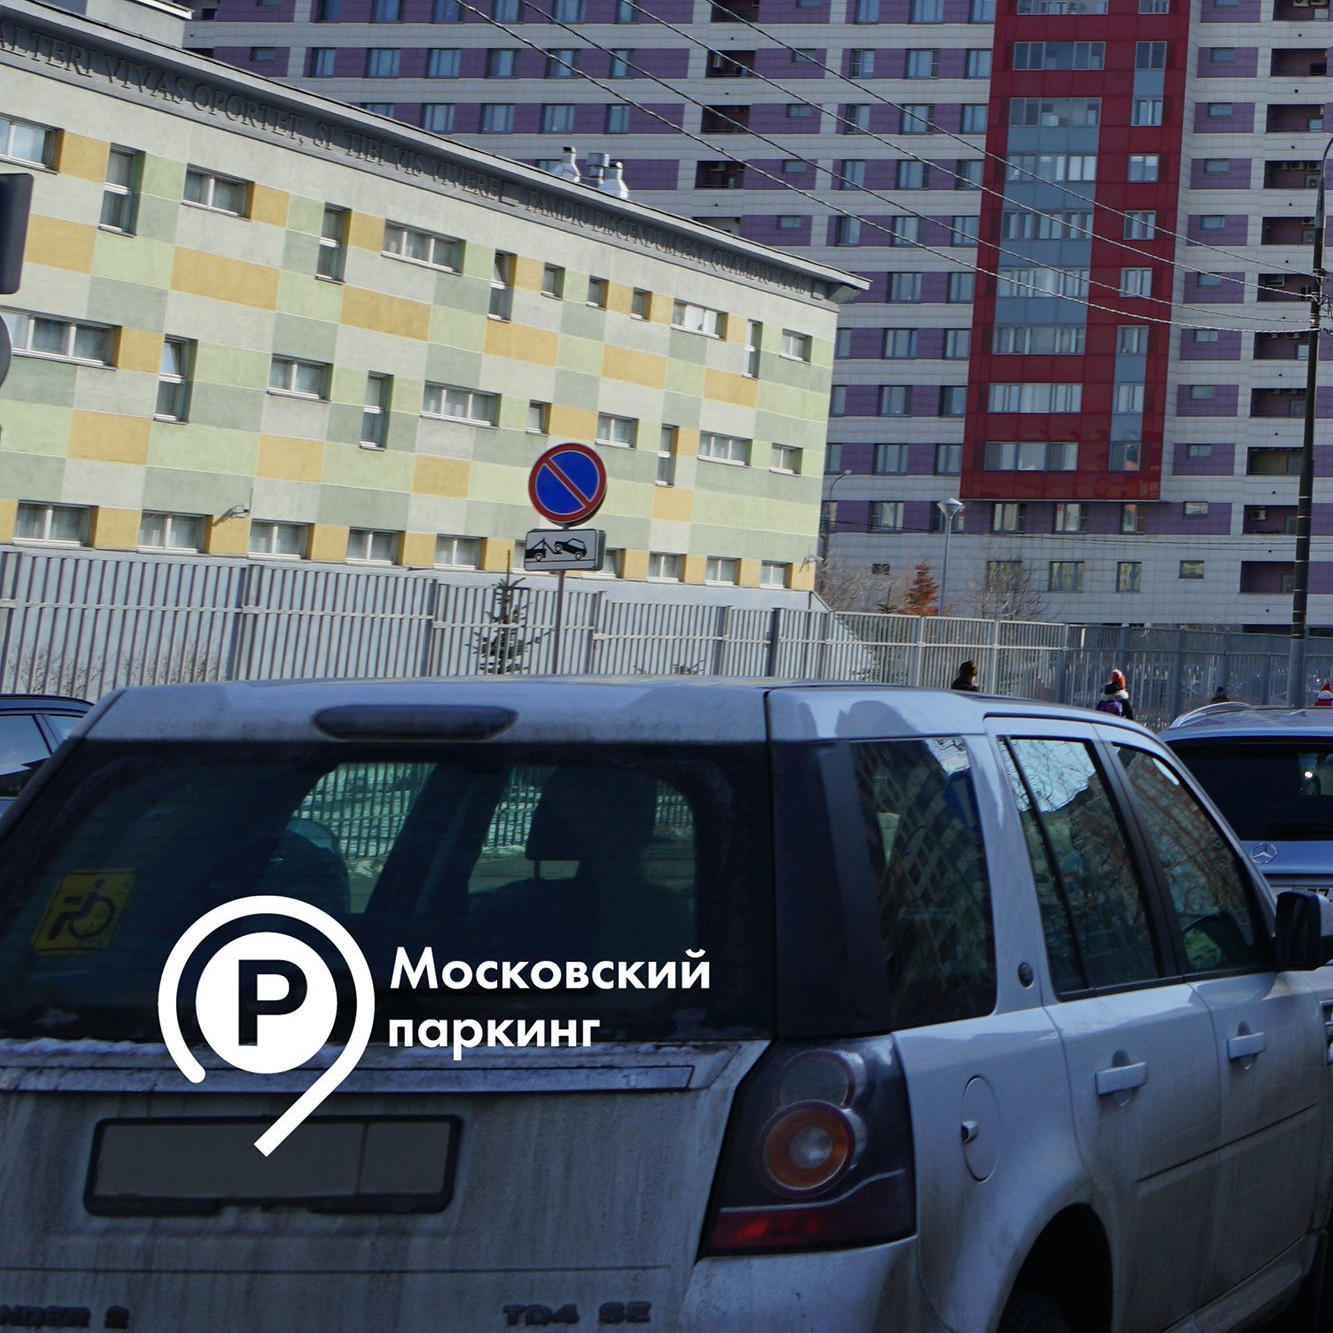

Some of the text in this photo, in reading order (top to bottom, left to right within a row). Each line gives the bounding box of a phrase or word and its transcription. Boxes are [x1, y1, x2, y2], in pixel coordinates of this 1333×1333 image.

[103, 53, 188, 104] VIVAS
[313, 122, 336, 151] SI
[502, 1301, 651, 1326] TD4 SE
